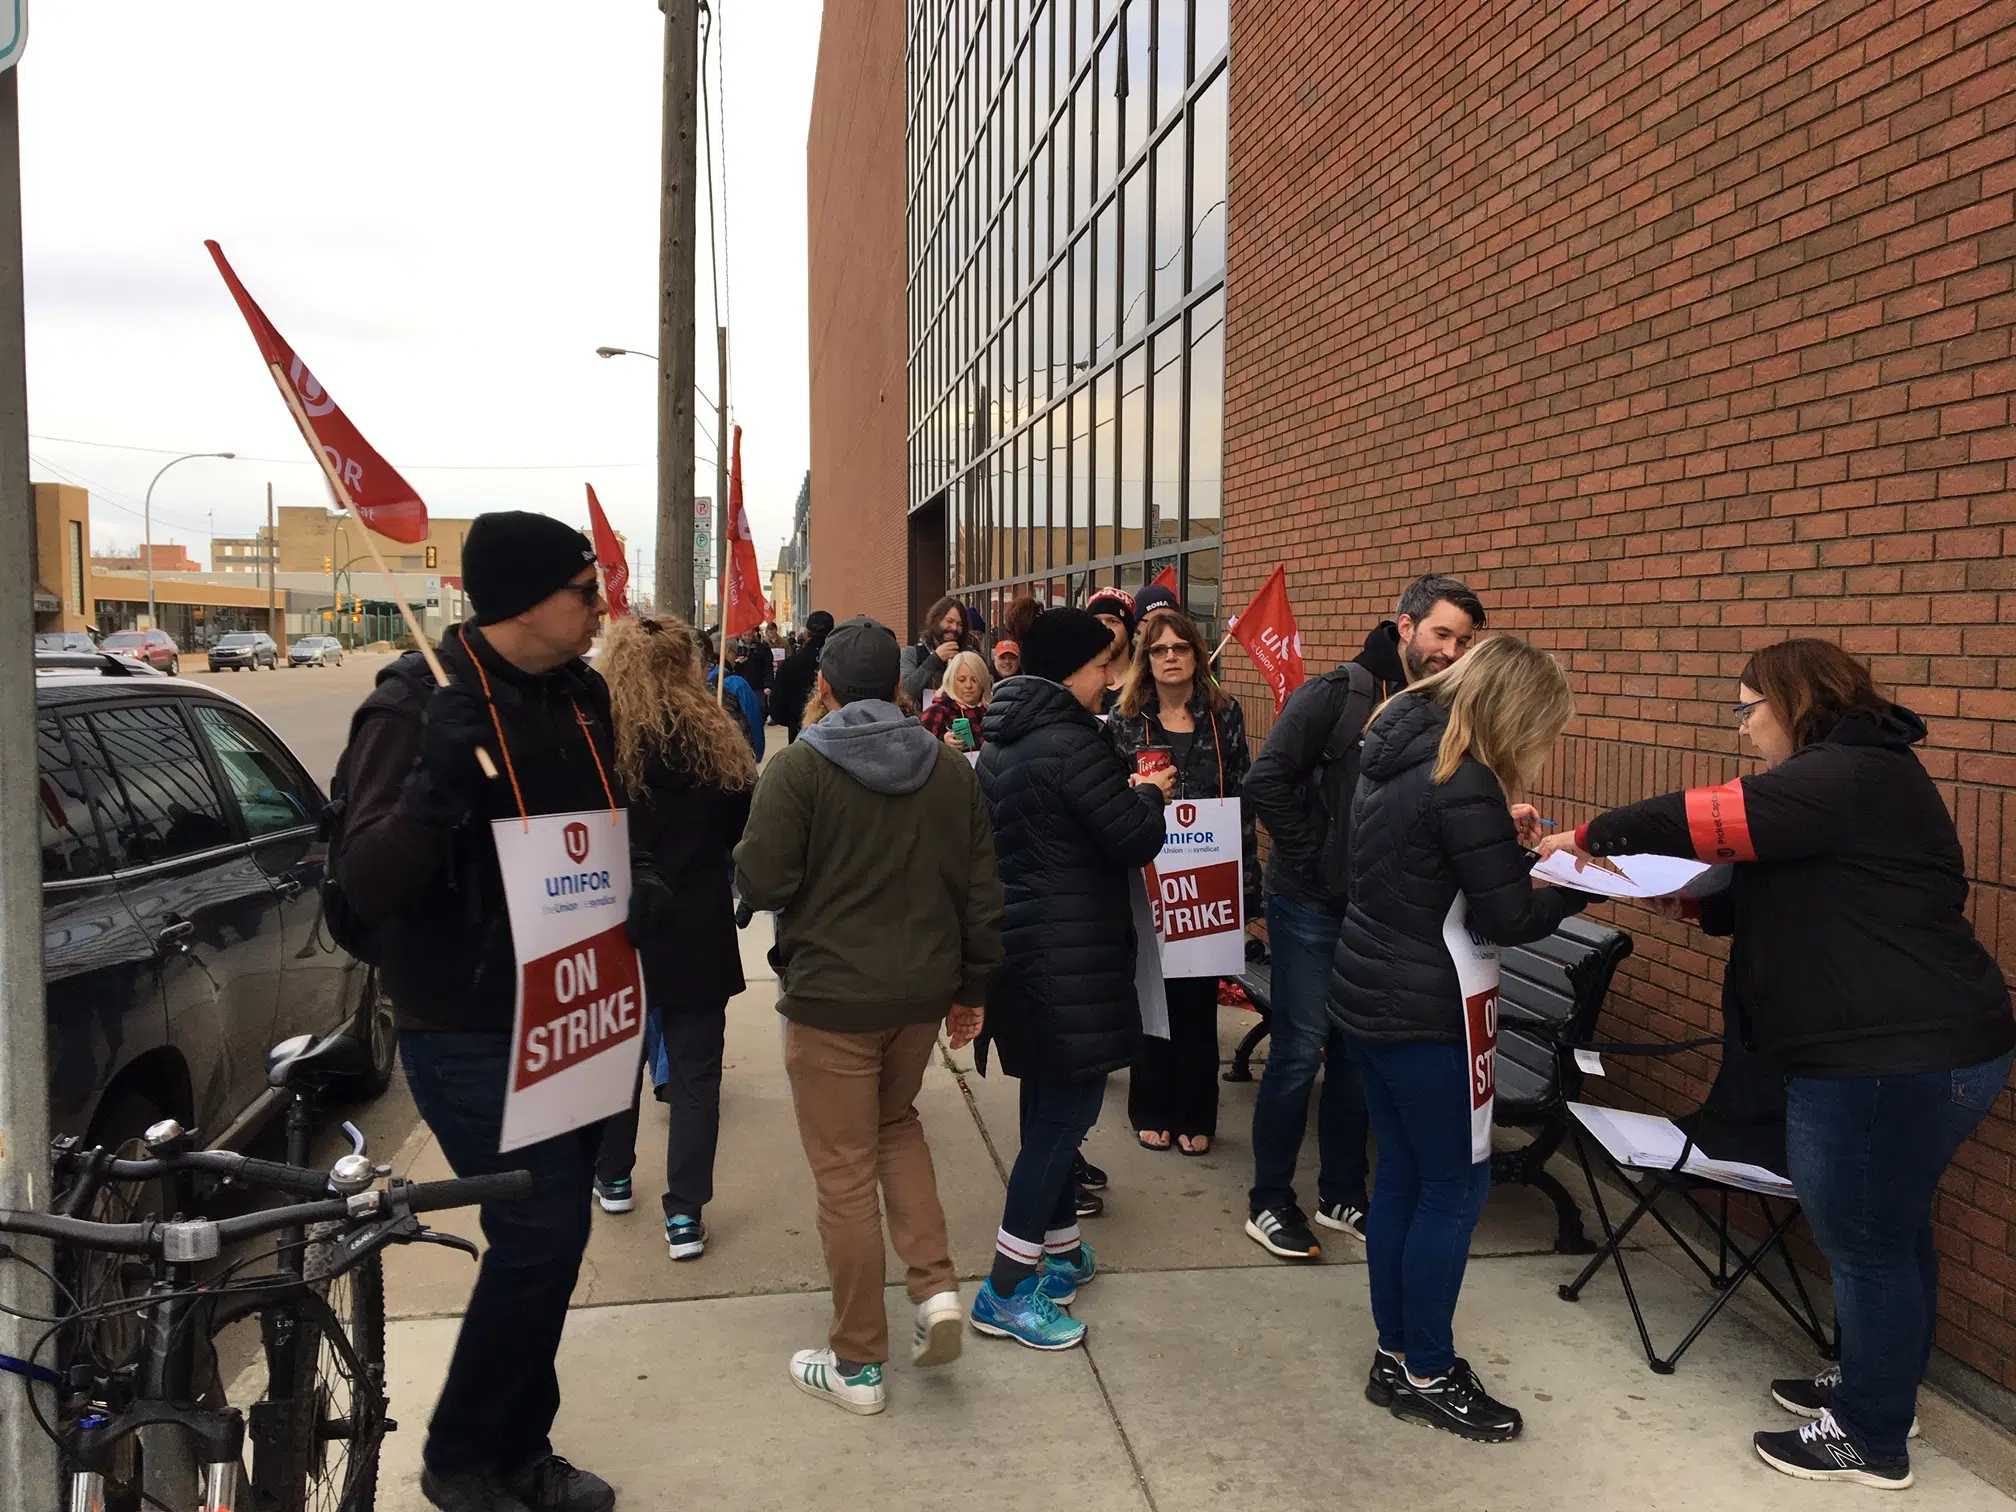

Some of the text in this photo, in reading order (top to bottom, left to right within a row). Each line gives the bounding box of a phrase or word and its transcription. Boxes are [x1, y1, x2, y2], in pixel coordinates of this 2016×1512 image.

[1146, 600, 1169, 612] RONA
[1714, 819, 1726, 844] Picket
[1162, 874, 1199, 904] ON
[1164, 899, 1235, 937] TRIKE
[555, 948, 599, 1005] ON
[526, 985, 636, 1074] STRIKE
